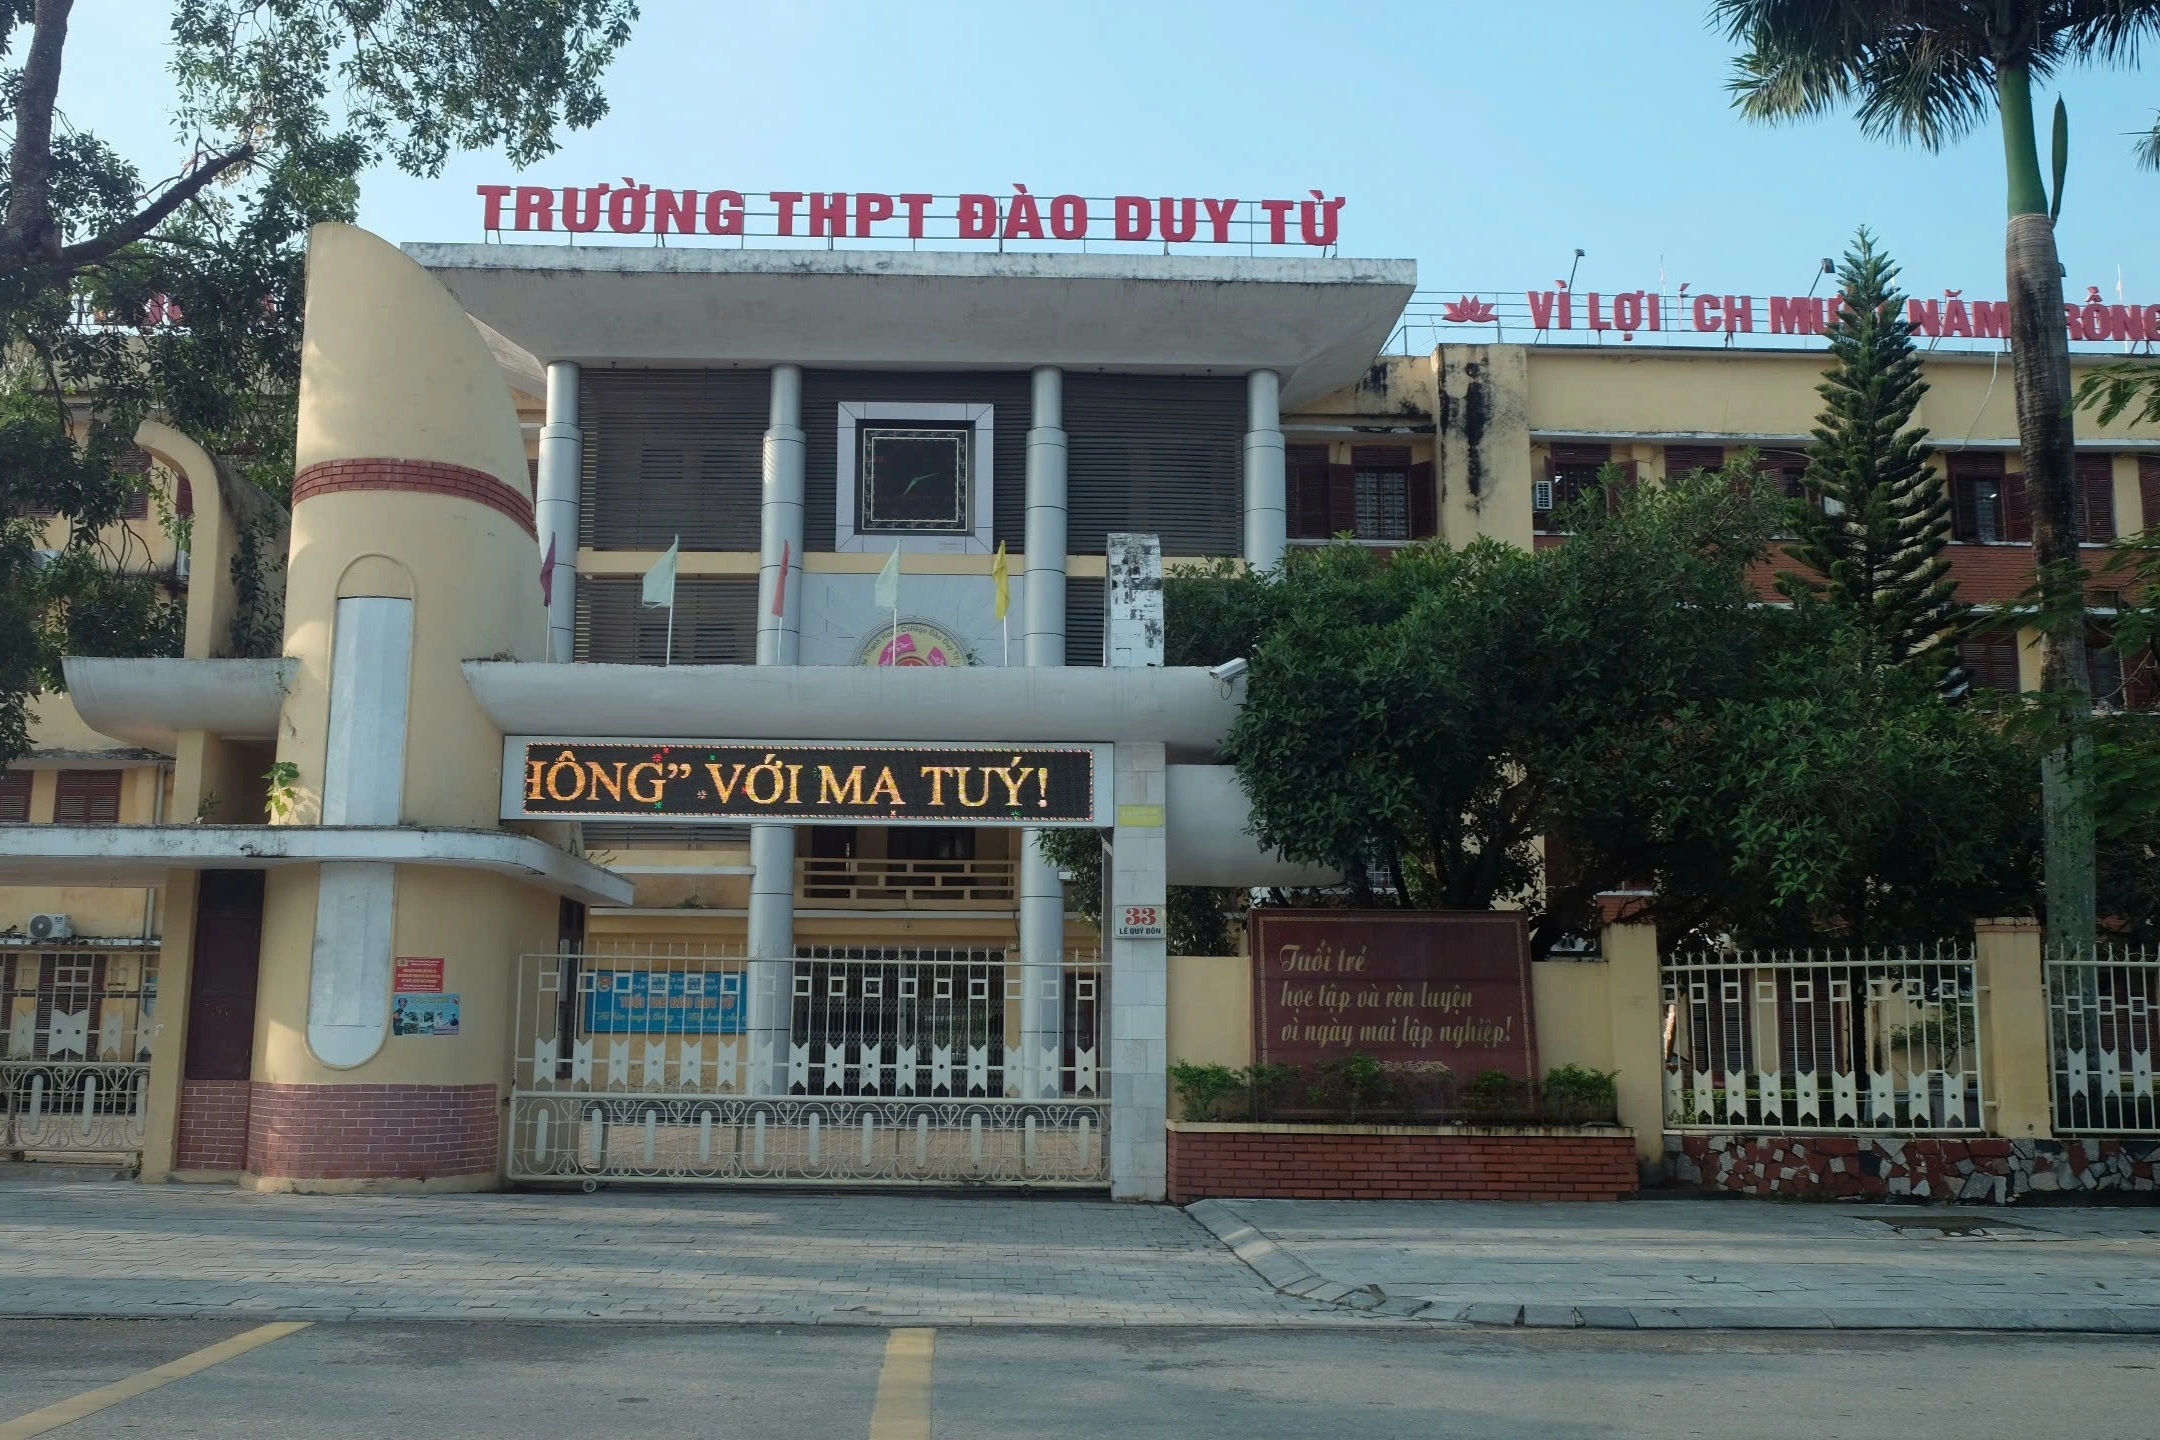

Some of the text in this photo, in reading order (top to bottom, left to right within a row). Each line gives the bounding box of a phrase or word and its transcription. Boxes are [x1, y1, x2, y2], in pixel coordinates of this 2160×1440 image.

[476, 176, 1346, 246] TRƯỜNG THPT ĐÀO DUY TỪ
[1527, 279, 1572, 330] VÌ
[1587, 289, 1661, 342] LỢI
[1906, 288, 2012, 338] NĂM
[705, 753, 803, 804] VỚI
[816, 766, 906, 805] MA
[920, 756, 1048, 808] TUÝ!
[1119, 927, 1128, 935] LÊ
[1146, 926, 1161, 935] ĐÔN
[1125, 907, 1157, 925] 33
[1279, 938, 1367, 972] Tuổi trẻ
[1281, 981, 1474, 1015] học tập và rèn luyện
[1281, 1015, 1513, 1048] vì ngày mai lập nghiệp!
